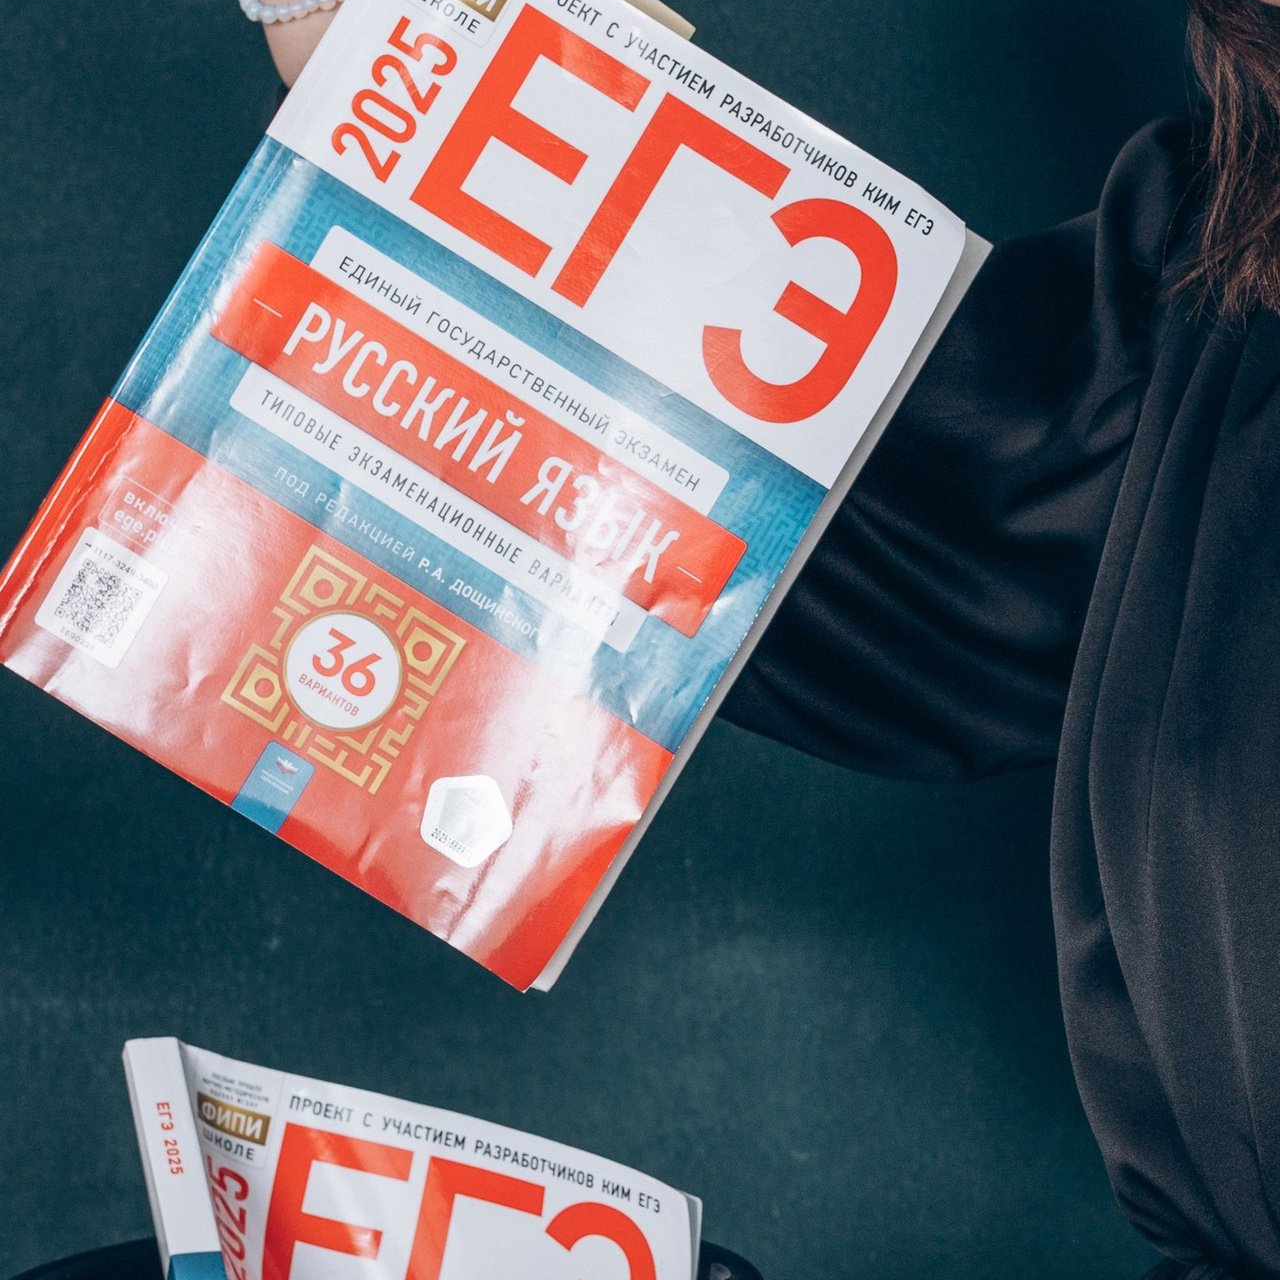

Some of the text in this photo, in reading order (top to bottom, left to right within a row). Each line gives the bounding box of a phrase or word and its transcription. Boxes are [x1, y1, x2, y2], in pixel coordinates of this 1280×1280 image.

[331, 16, 457, 183] 2025
[605, 22, 620, 38] С
[624, 32, 717, 99] УЧАСТИЕМ
[719, 92, 859, 188] РАЗРАБОТЧИКОВ
[861, 182, 902, 216] КИМ
[904, 208, 935, 236] ЕГЭ
[409, 4, 898, 424] ЕГЭ
[338, 255, 701, 492] ЕДИНЫЙ ГОСУДАРСТВЕННЫЙ ЭКЗАМЕН
[260, 389, 343, 452] ТИПОВЫЕ
[347, 446, 523, 565] ЭКЗАМЕНАЦИОННЫЕ
[282, 301, 681, 584] РУССКИЙ ЯЗЫК
[274, 467, 312, 498] ПОД
[314, 493, 417, 563] РЕДАКЦИЕЙ
[298, 673, 360, 717] ВАРИАНТОВ
[312, 627, 382, 697] 36
[156, 1101, 185, 1176] ЕГЭ 2025
[201, 1098, 263, 1141] ФИПИ
[202, 1126, 256, 1162] ШКОЛЕ
[289, 1094, 355, 1124] ПРОЕКТ
[362, 1112, 374, 1128] С
[381, 1116, 467, 1150] УЧАСТИЕМ
[474, 1139, 595, 1189] РАЗРАБОТЧИКОВ
[601, 1178, 632, 1201] КИМ
[638, 1192, 661, 1214] ЕГЭ
